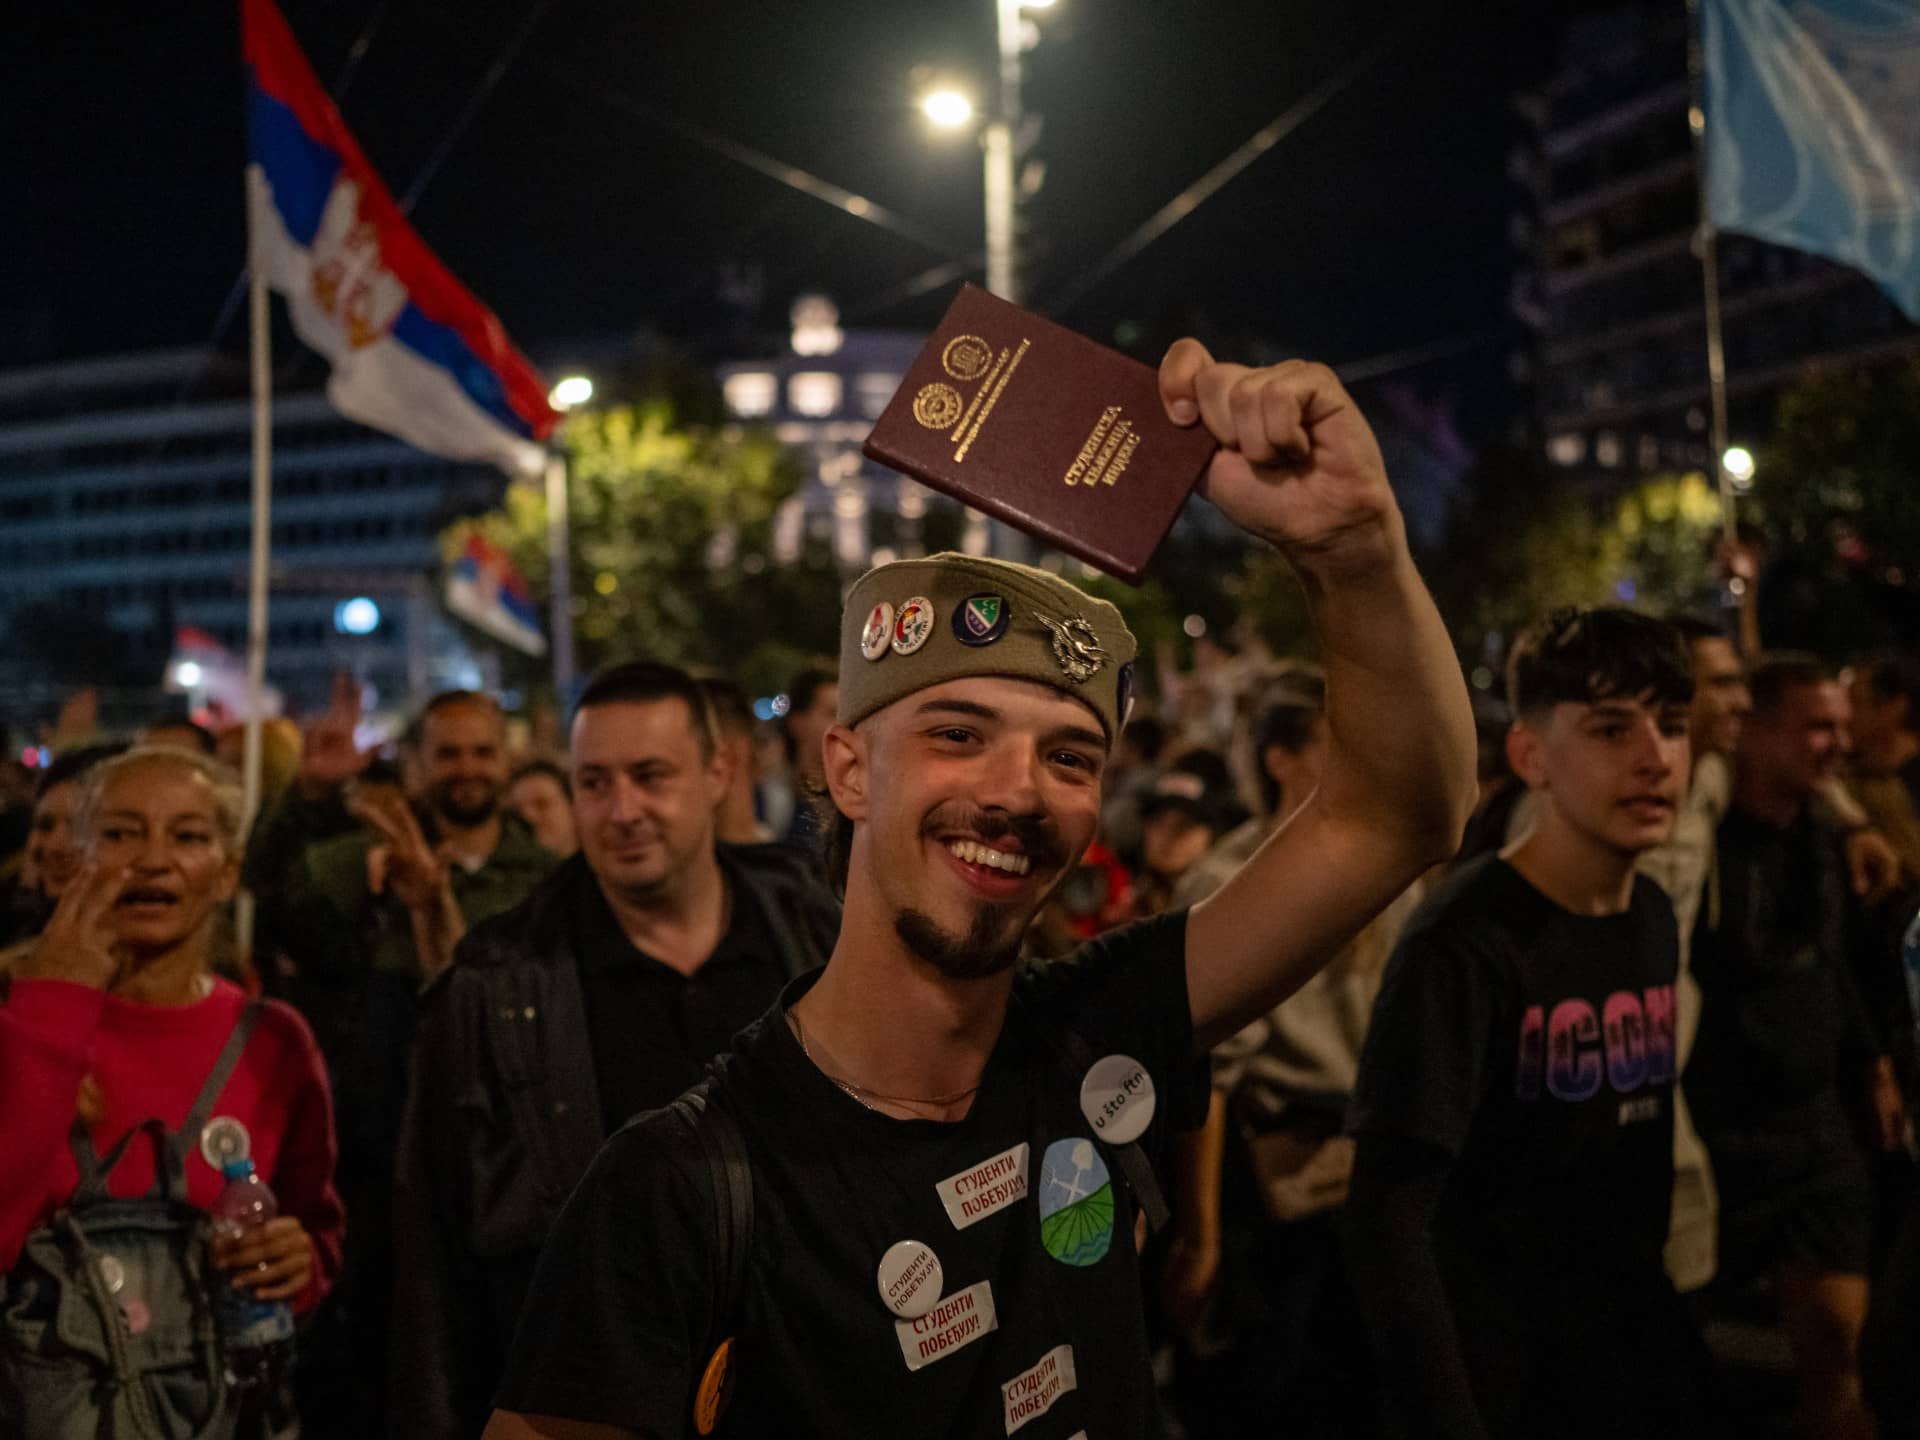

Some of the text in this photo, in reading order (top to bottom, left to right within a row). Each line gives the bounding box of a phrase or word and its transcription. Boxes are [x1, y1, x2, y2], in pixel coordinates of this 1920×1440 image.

[1064, 406, 1122, 486] СТУДЕНТСКА
[1102, 433, 1140, 487] ИНДЕКС
[1104, 1094, 1125, 1118] što
[954, 1155, 1016, 1195] СТУДЕНТИ
[961, 1175, 1026, 1217] ПОБЕЂУЈУ!
[888, 1250, 928, 1297] СТУДЕНТИ
[912, 1292, 975, 1334] СТУДЕНТИ
[918, 1314, 980, 1358] ПОБЕЂУЈУ!
